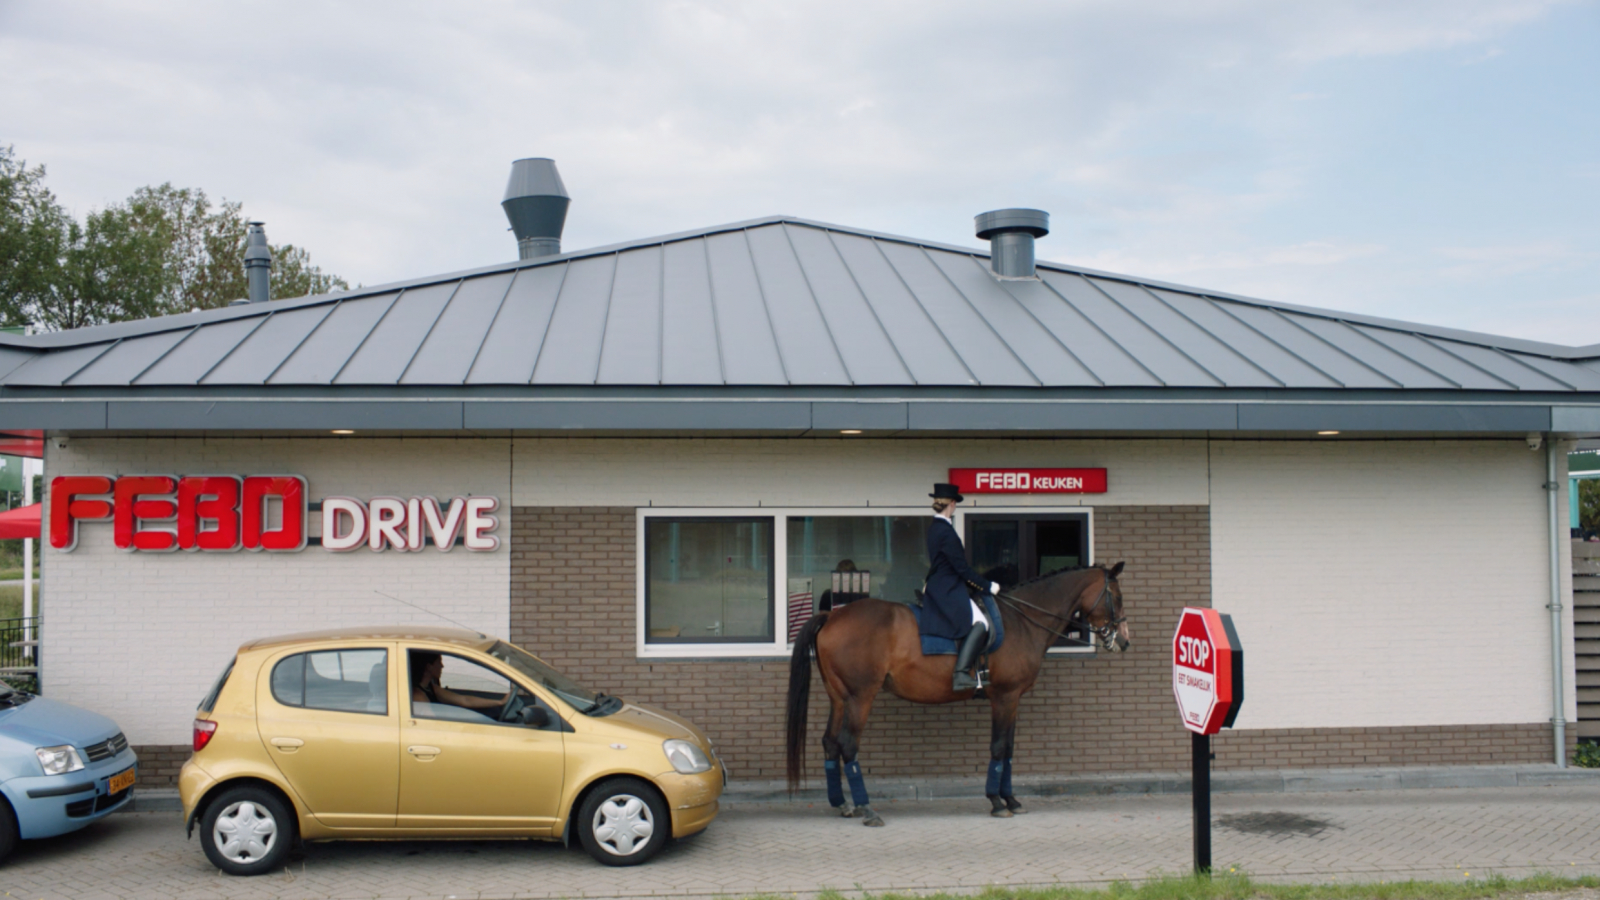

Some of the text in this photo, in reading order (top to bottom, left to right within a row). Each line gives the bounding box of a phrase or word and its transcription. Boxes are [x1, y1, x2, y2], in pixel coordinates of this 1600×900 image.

[975, 472, 1083, 489] FEBO KEUKEN
[49, 475, 499, 552] FEBO DRIVE
[1178, 634, 1210, 668] STOP
[1178, 672, 1186, 685] EET
